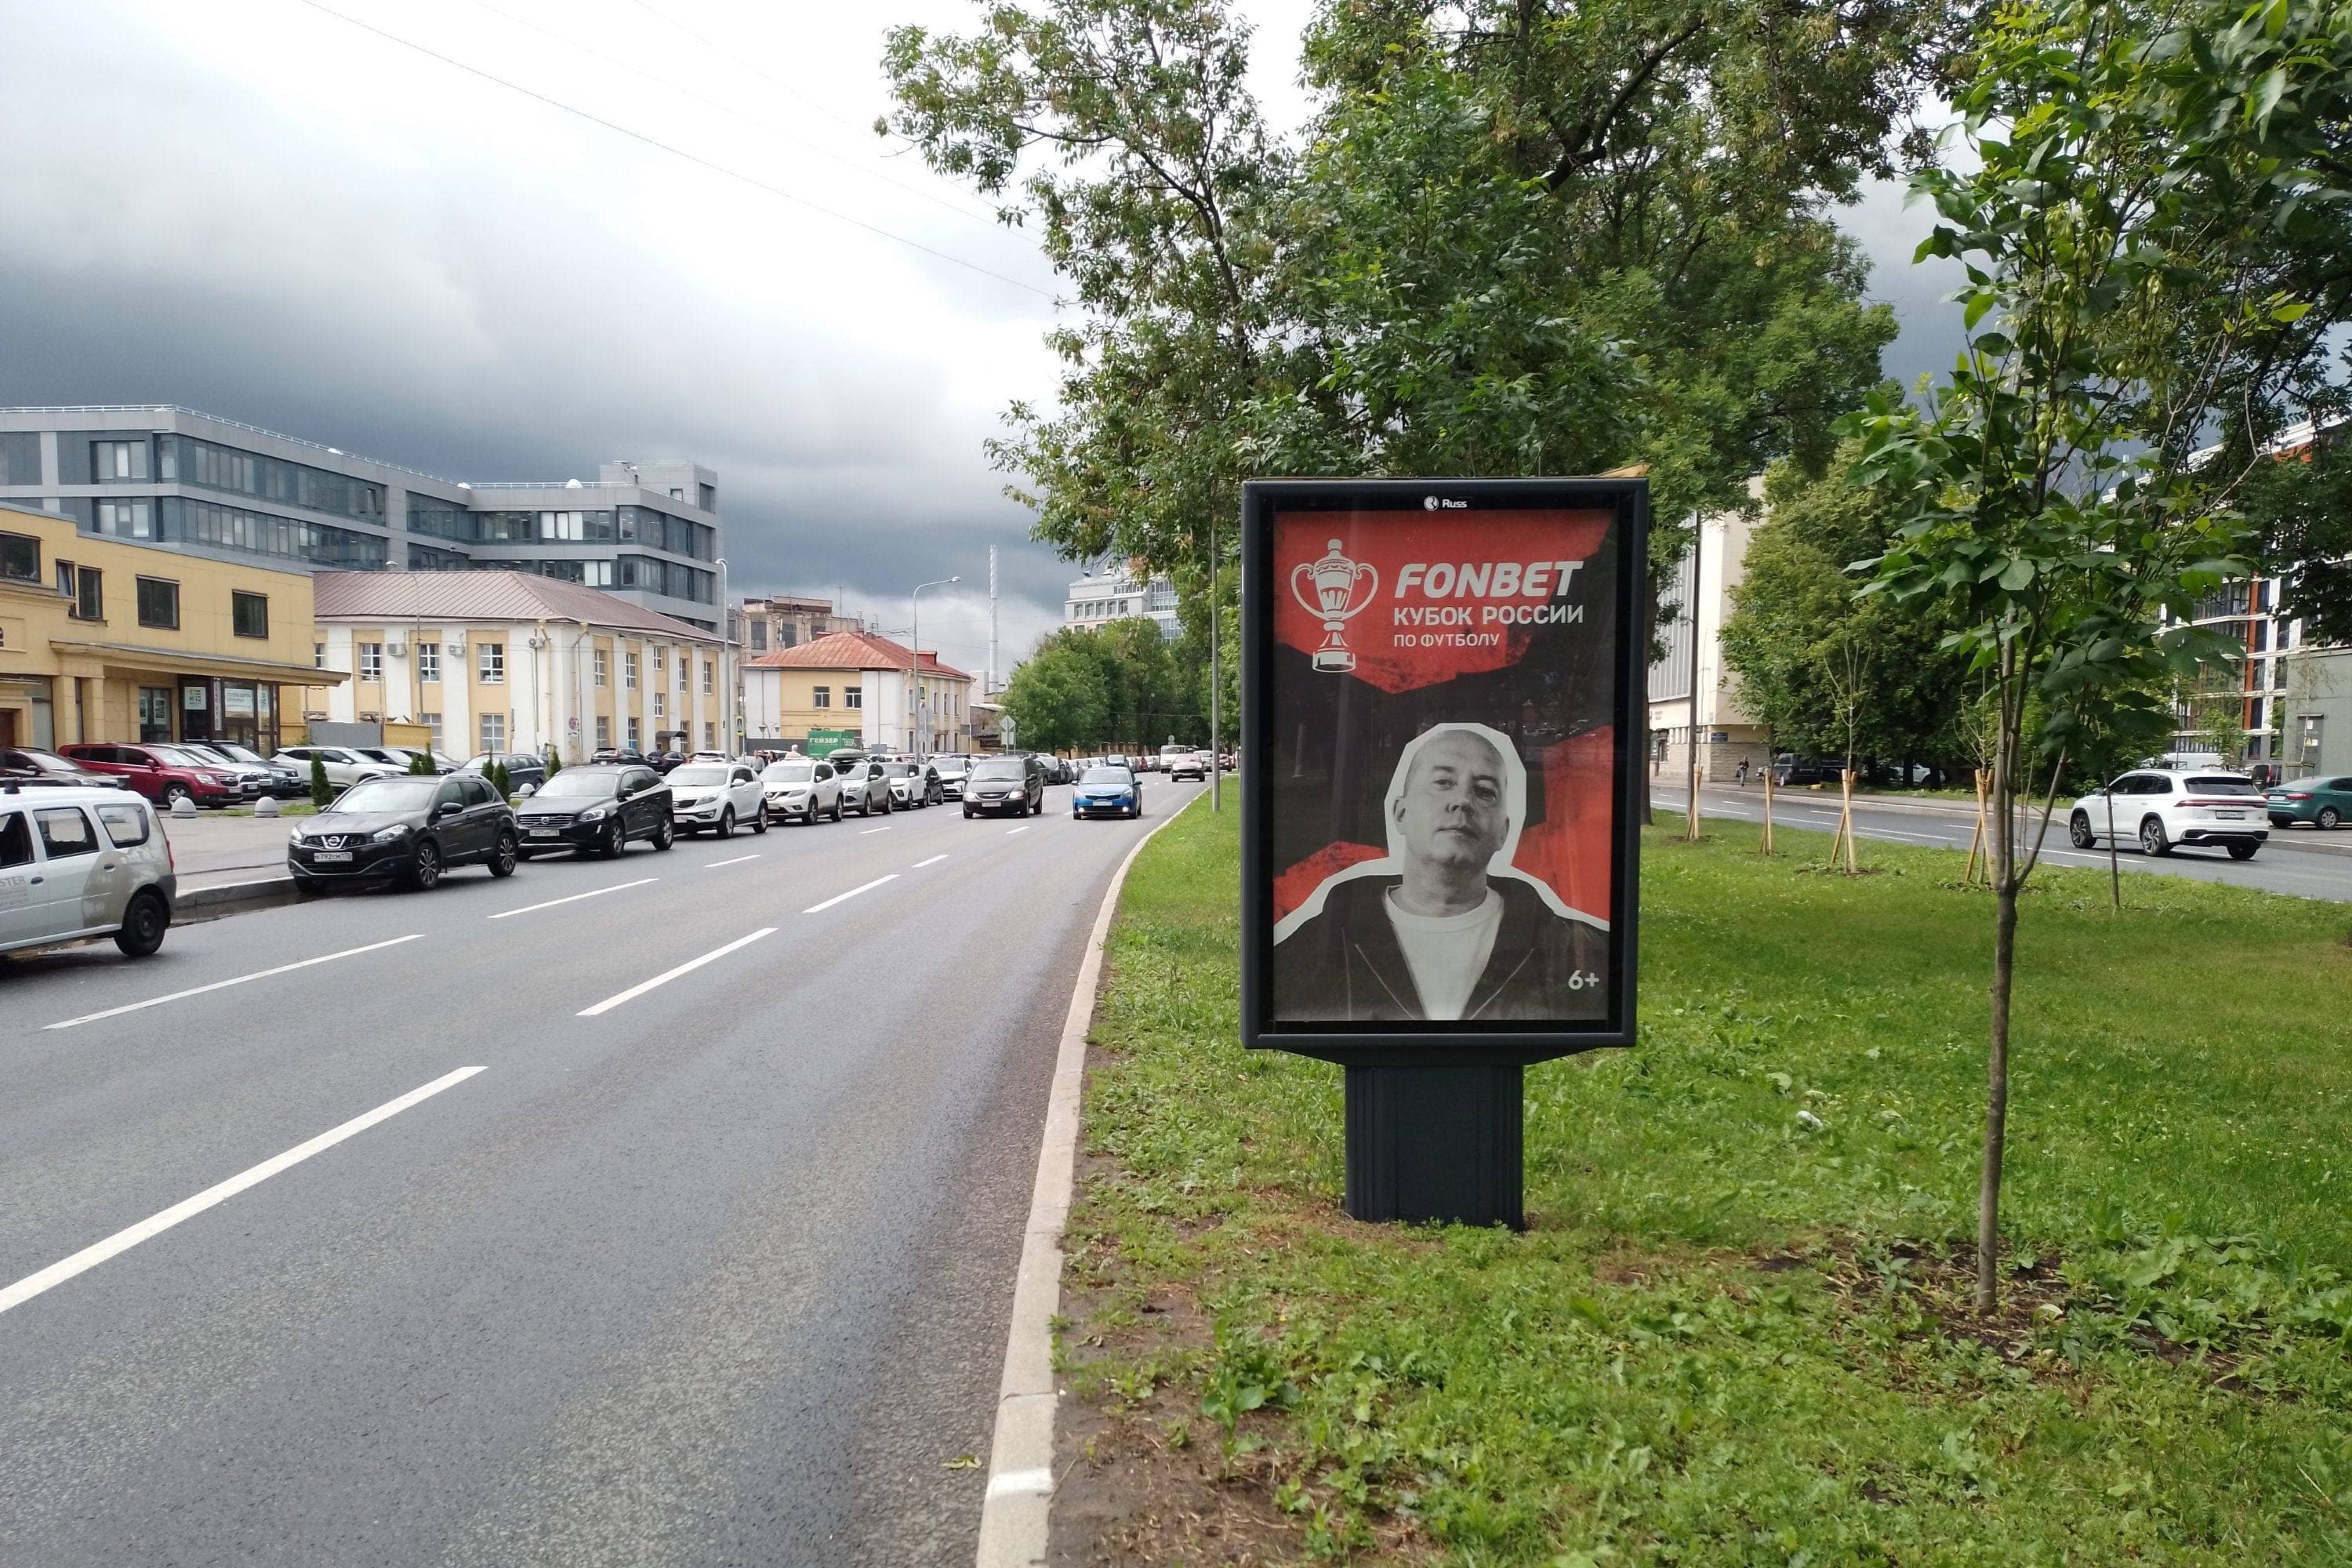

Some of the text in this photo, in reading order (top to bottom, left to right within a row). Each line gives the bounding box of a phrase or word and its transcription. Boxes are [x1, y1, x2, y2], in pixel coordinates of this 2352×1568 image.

[1442, 499, 1468, 508] Russ
[1394, 561, 1584, 598] FONBET
[1394, 604, 1584, 626] КУБОК РОССИИ
[1394, 633, 1501, 648] ПО ФУТБОЛУ
[1568, 969, 1600, 989] 6+
